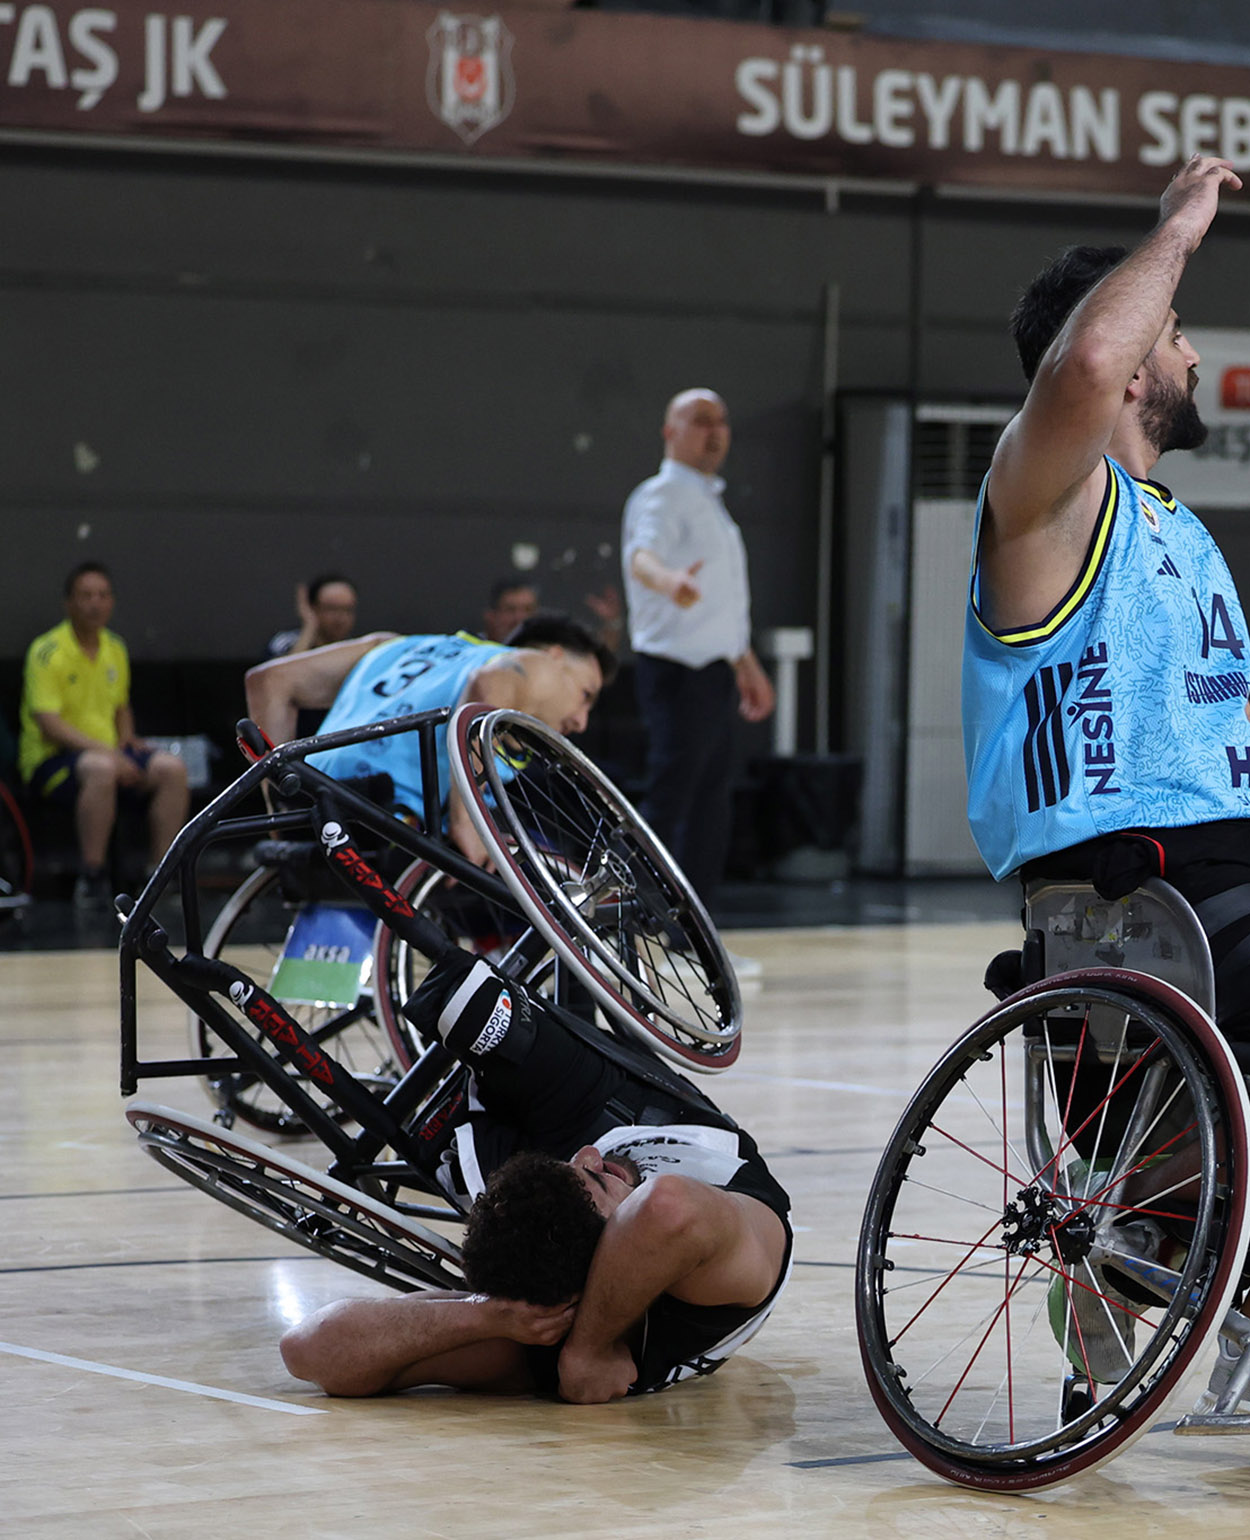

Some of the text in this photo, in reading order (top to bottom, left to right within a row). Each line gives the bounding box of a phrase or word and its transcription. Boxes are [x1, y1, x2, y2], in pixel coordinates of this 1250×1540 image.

[137, 14, 228, 112] JK
[736, 44, 1121, 162] SÜLEYMAN
[1191, 586, 1245, 660] 14
[1182, 664, 1249, 705] İSTANBU
